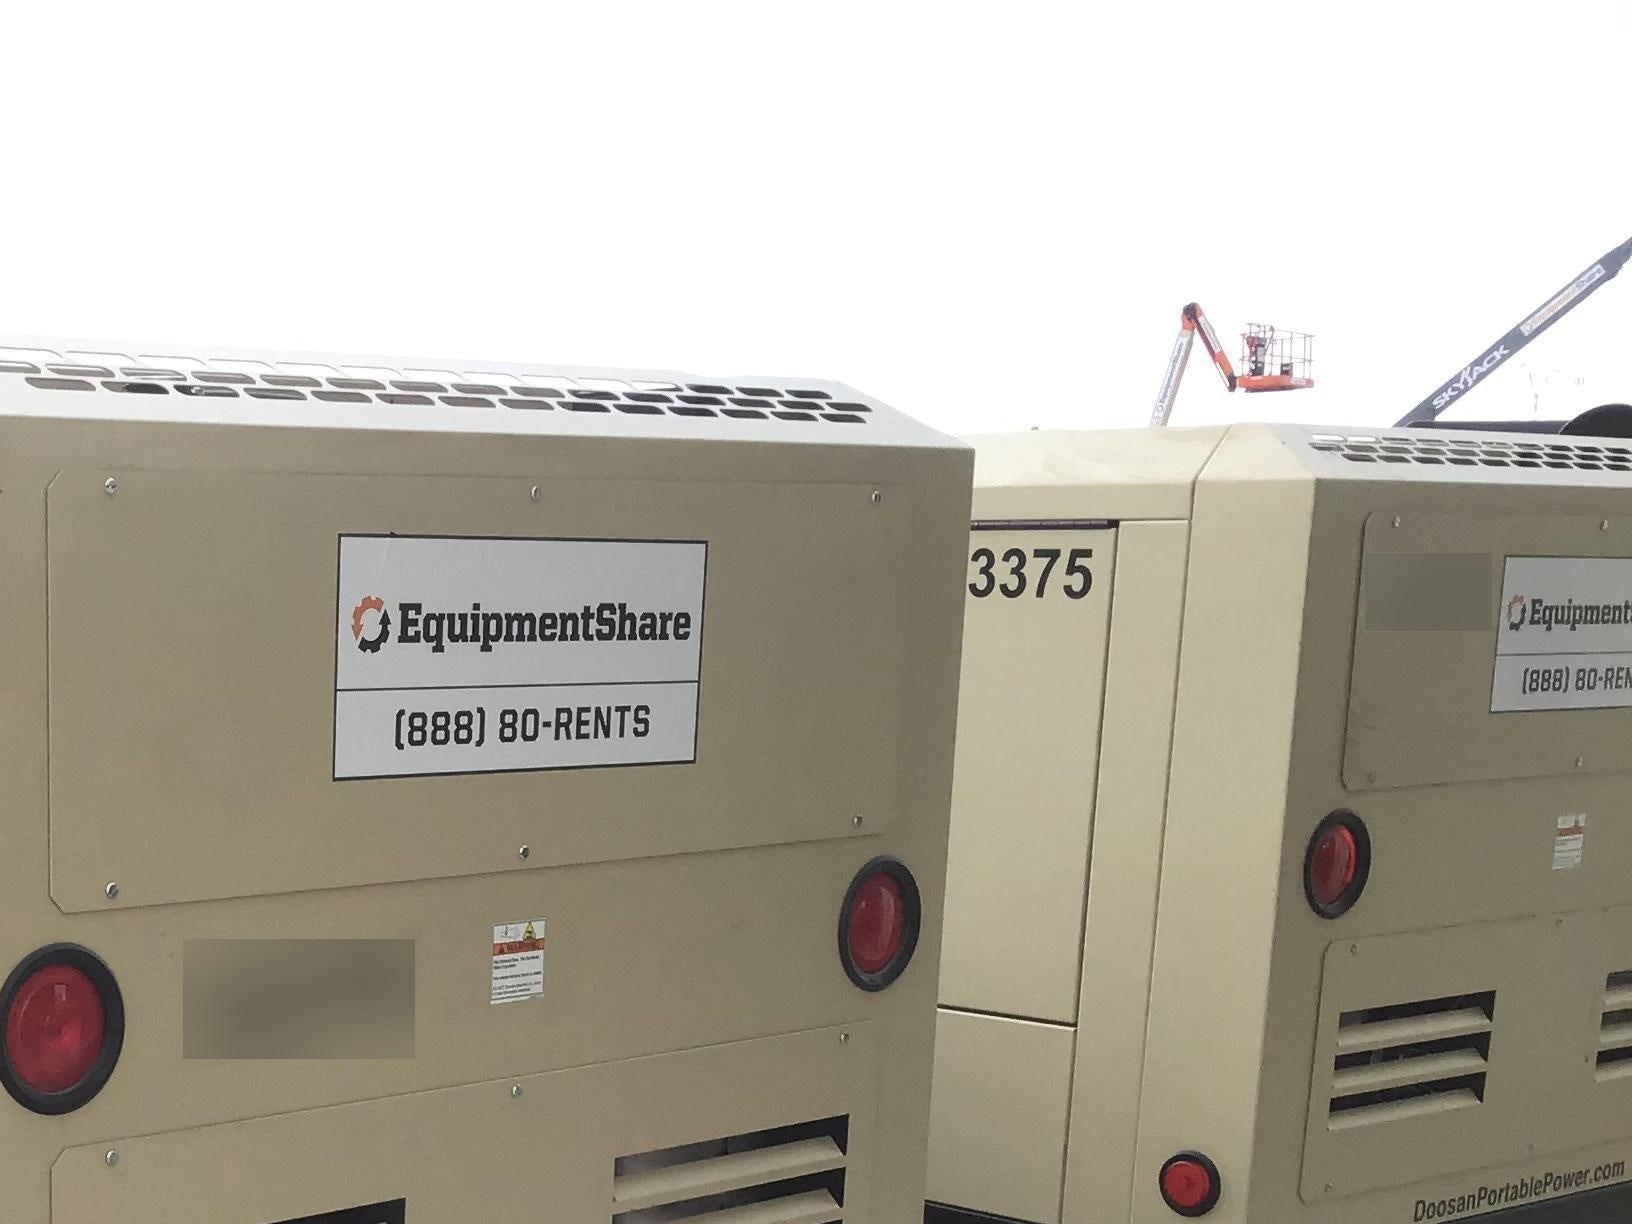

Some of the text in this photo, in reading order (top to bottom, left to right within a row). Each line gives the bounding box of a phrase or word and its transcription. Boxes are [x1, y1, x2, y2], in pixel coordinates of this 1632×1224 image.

[1432, 344, 1510, 409] SKYJACK
[968, 548, 1093, 599] 3375
[397, 602, 691, 653] EquipmentShare
[1529, 598, 1632, 631] Equipment
[1522, 666, 1569, 695] (888)
[395, 704, 650, 750] (888) 80-RENTS
[1414, 1160, 1625, 1222] DoosanPortablePower.com
